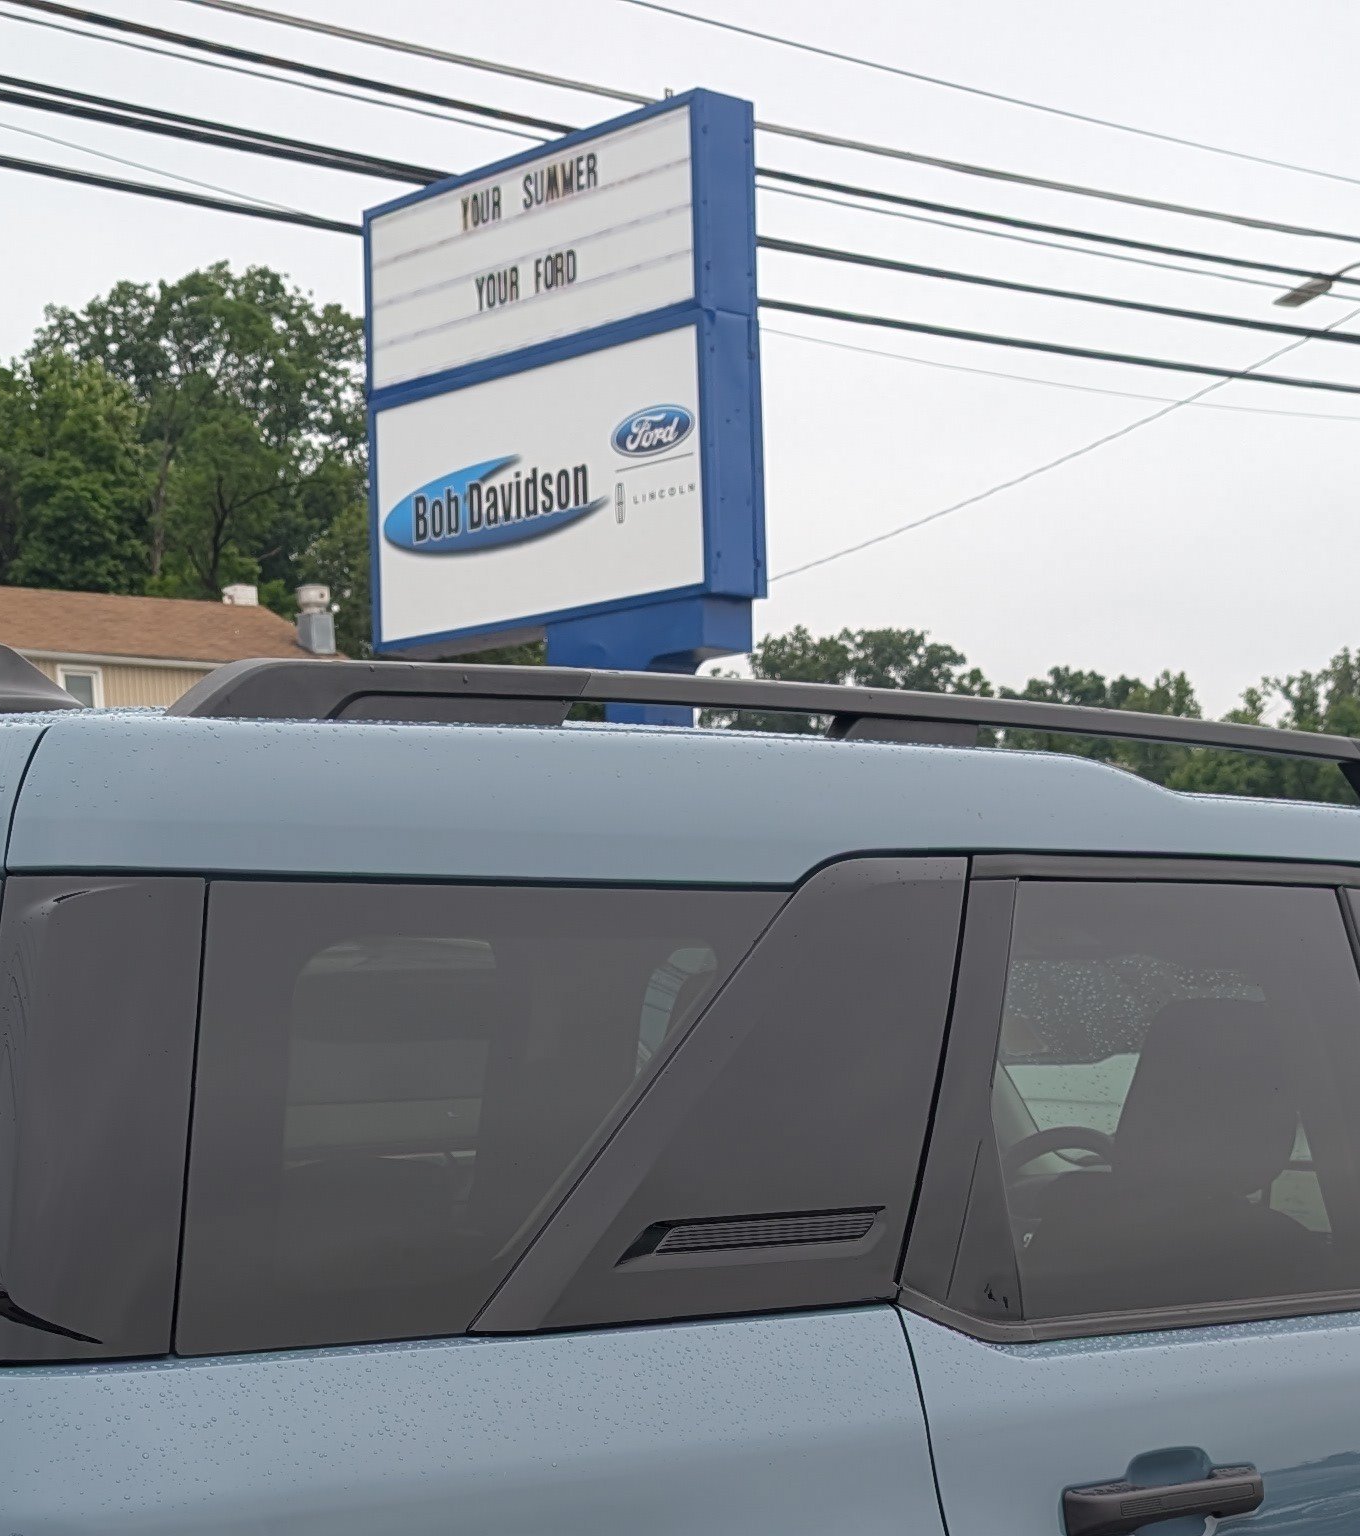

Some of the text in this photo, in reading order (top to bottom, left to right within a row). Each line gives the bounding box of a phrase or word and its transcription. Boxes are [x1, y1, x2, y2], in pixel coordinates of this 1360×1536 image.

[461, 152, 598, 232] YOUR SUMMER
[475, 248, 577, 312] YOUR FORD
[624, 411, 679, 452] Ford
[413, 463, 590, 544] Bob Davidson
[632, 482, 696, 505] LINCOLN
